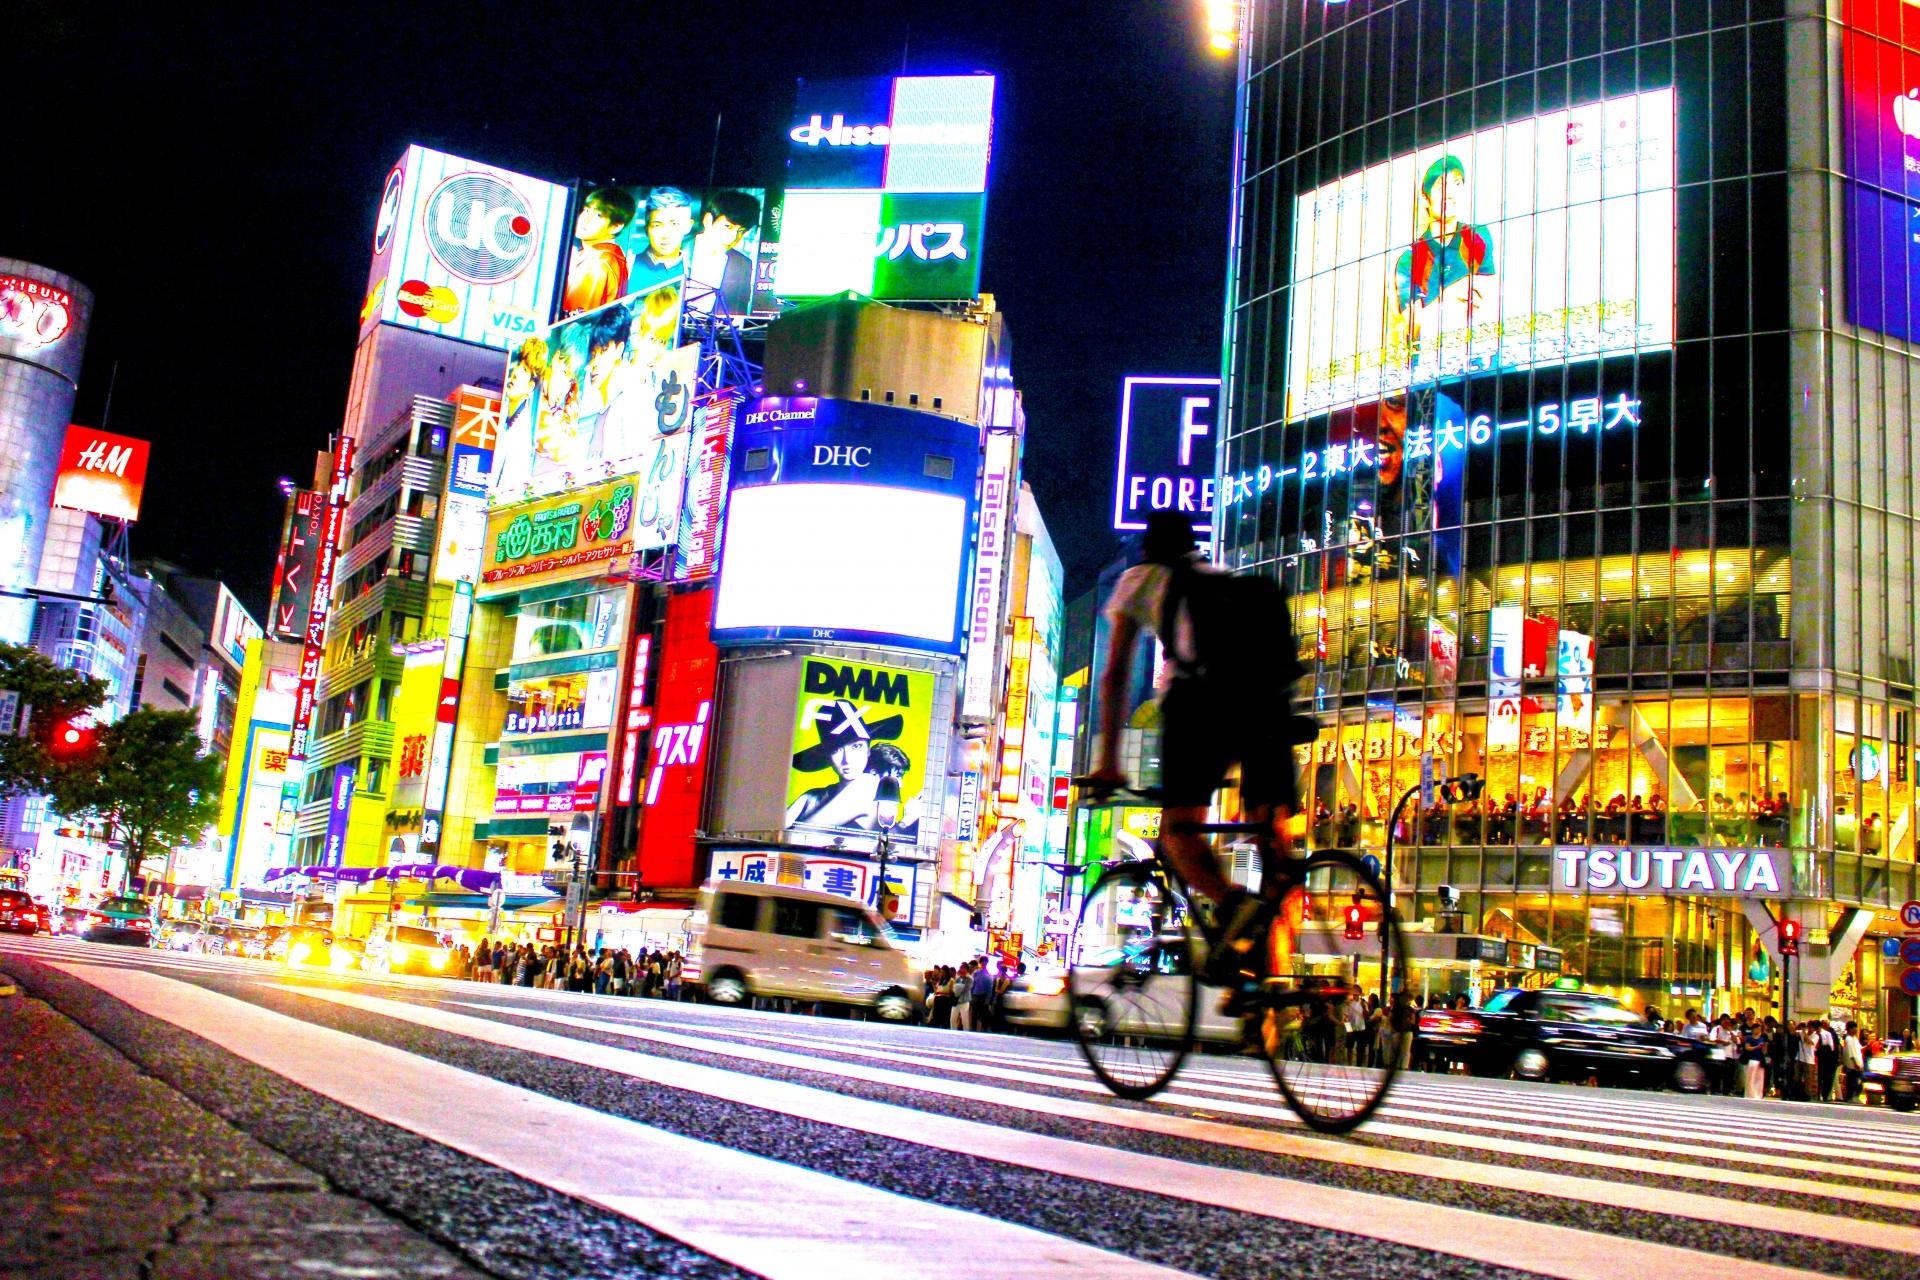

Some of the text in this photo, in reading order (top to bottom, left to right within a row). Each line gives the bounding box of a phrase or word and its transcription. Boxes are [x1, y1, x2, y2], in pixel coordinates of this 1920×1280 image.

[493, 312, 536, 333] VISA
[745, 408, 816, 425] DHC Channel
[78, 440, 133, 477] H&M
[812, 445, 872, 468] DHC
[309, 494, 323, 537] TOKYO
[973, 466, 1007, 643] Taisei neon
[812, 628, 835, 639] DHC
[804, 660, 910, 708] DMM
[506, 706, 580, 735] Euphoria
[800, 697, 871, 740] FX
[1297, 730, 1465, 766] STARBUCKS
[1557, 849, 1781, 892] TSUTAYA
